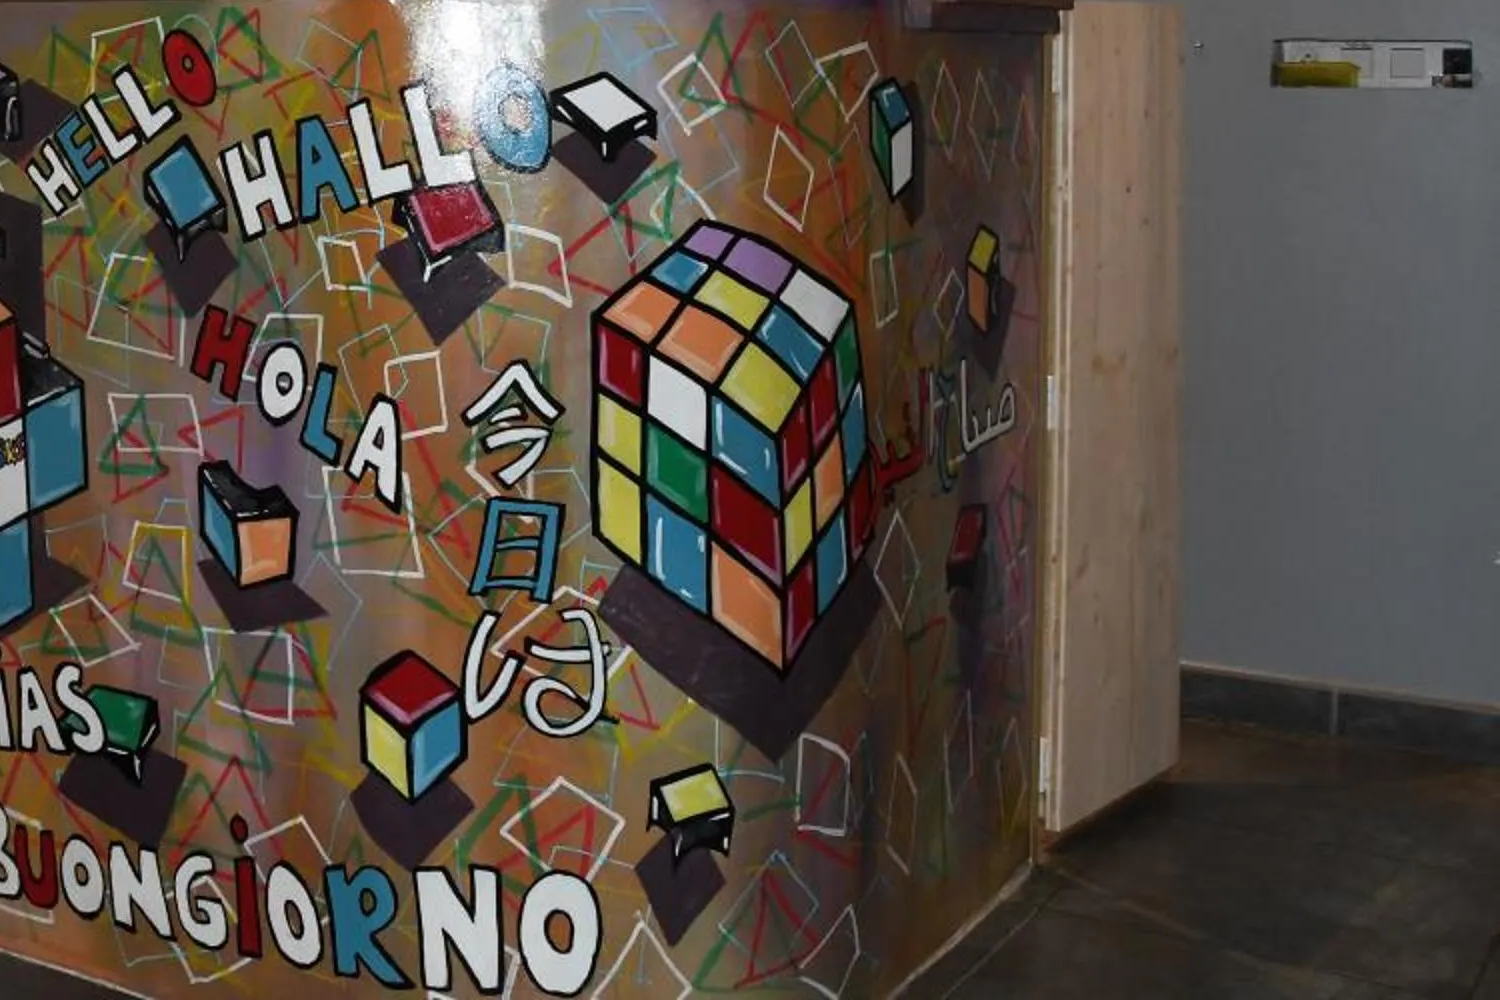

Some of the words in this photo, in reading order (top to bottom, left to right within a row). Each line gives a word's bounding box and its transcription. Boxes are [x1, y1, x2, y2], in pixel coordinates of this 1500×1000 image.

[24, 27, 218, 217] HELLO
[217, 64, 553, 243] HALLO
[190, 304, 402, 514] HOLA
